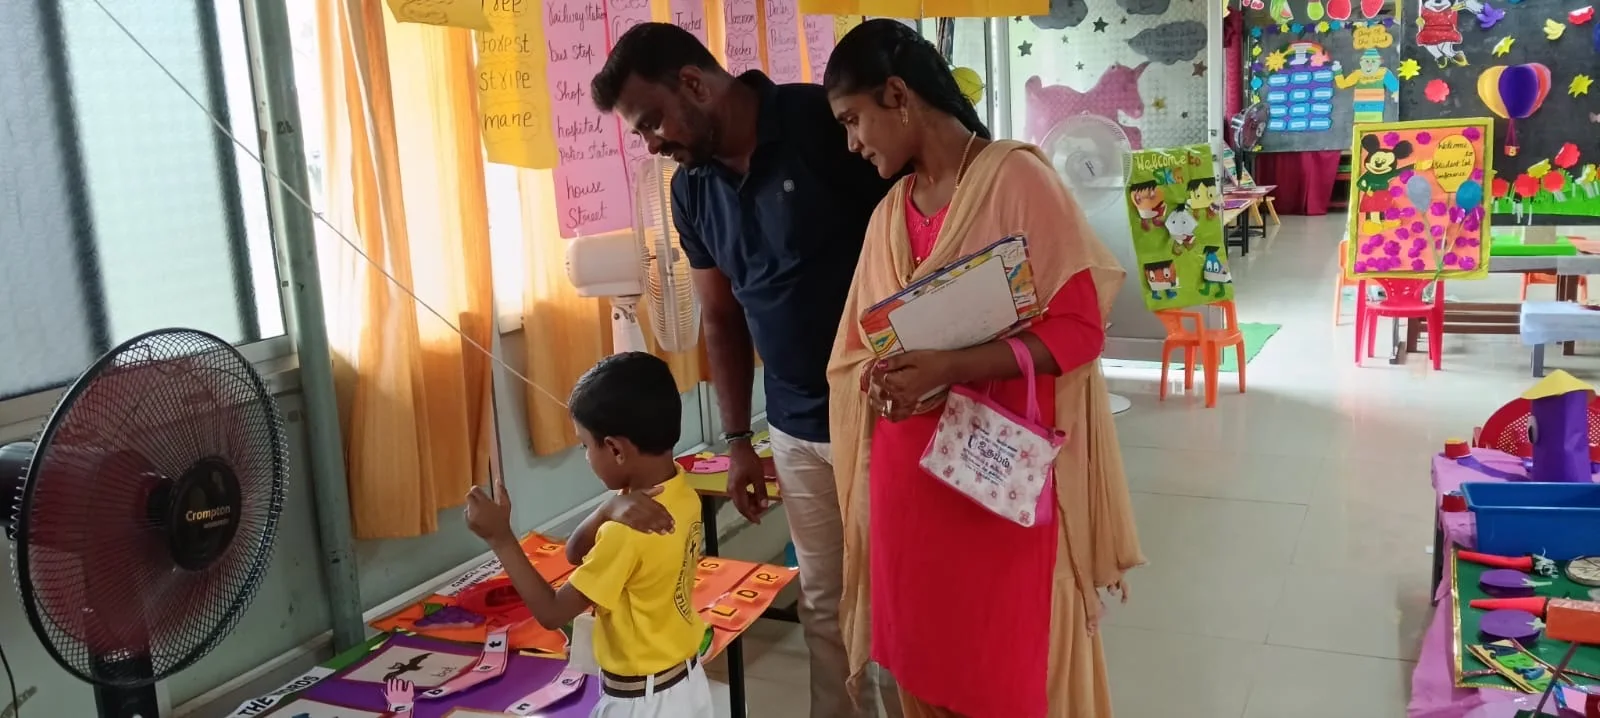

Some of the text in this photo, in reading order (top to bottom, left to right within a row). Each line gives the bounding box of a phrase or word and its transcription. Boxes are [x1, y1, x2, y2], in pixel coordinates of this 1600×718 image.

[483, 111, 535, 130] mane
[557, 114, 603, 142] hospital
[1134, 150, 1202, 171] Welcome to
[1153, 167, 1185, 185] SKG
[566, 175, 605, 200] house
[185, 505, 231, 522] Crompton
[711, 572, 779, 617] L D R
[238, 696, 274, 717] THE
